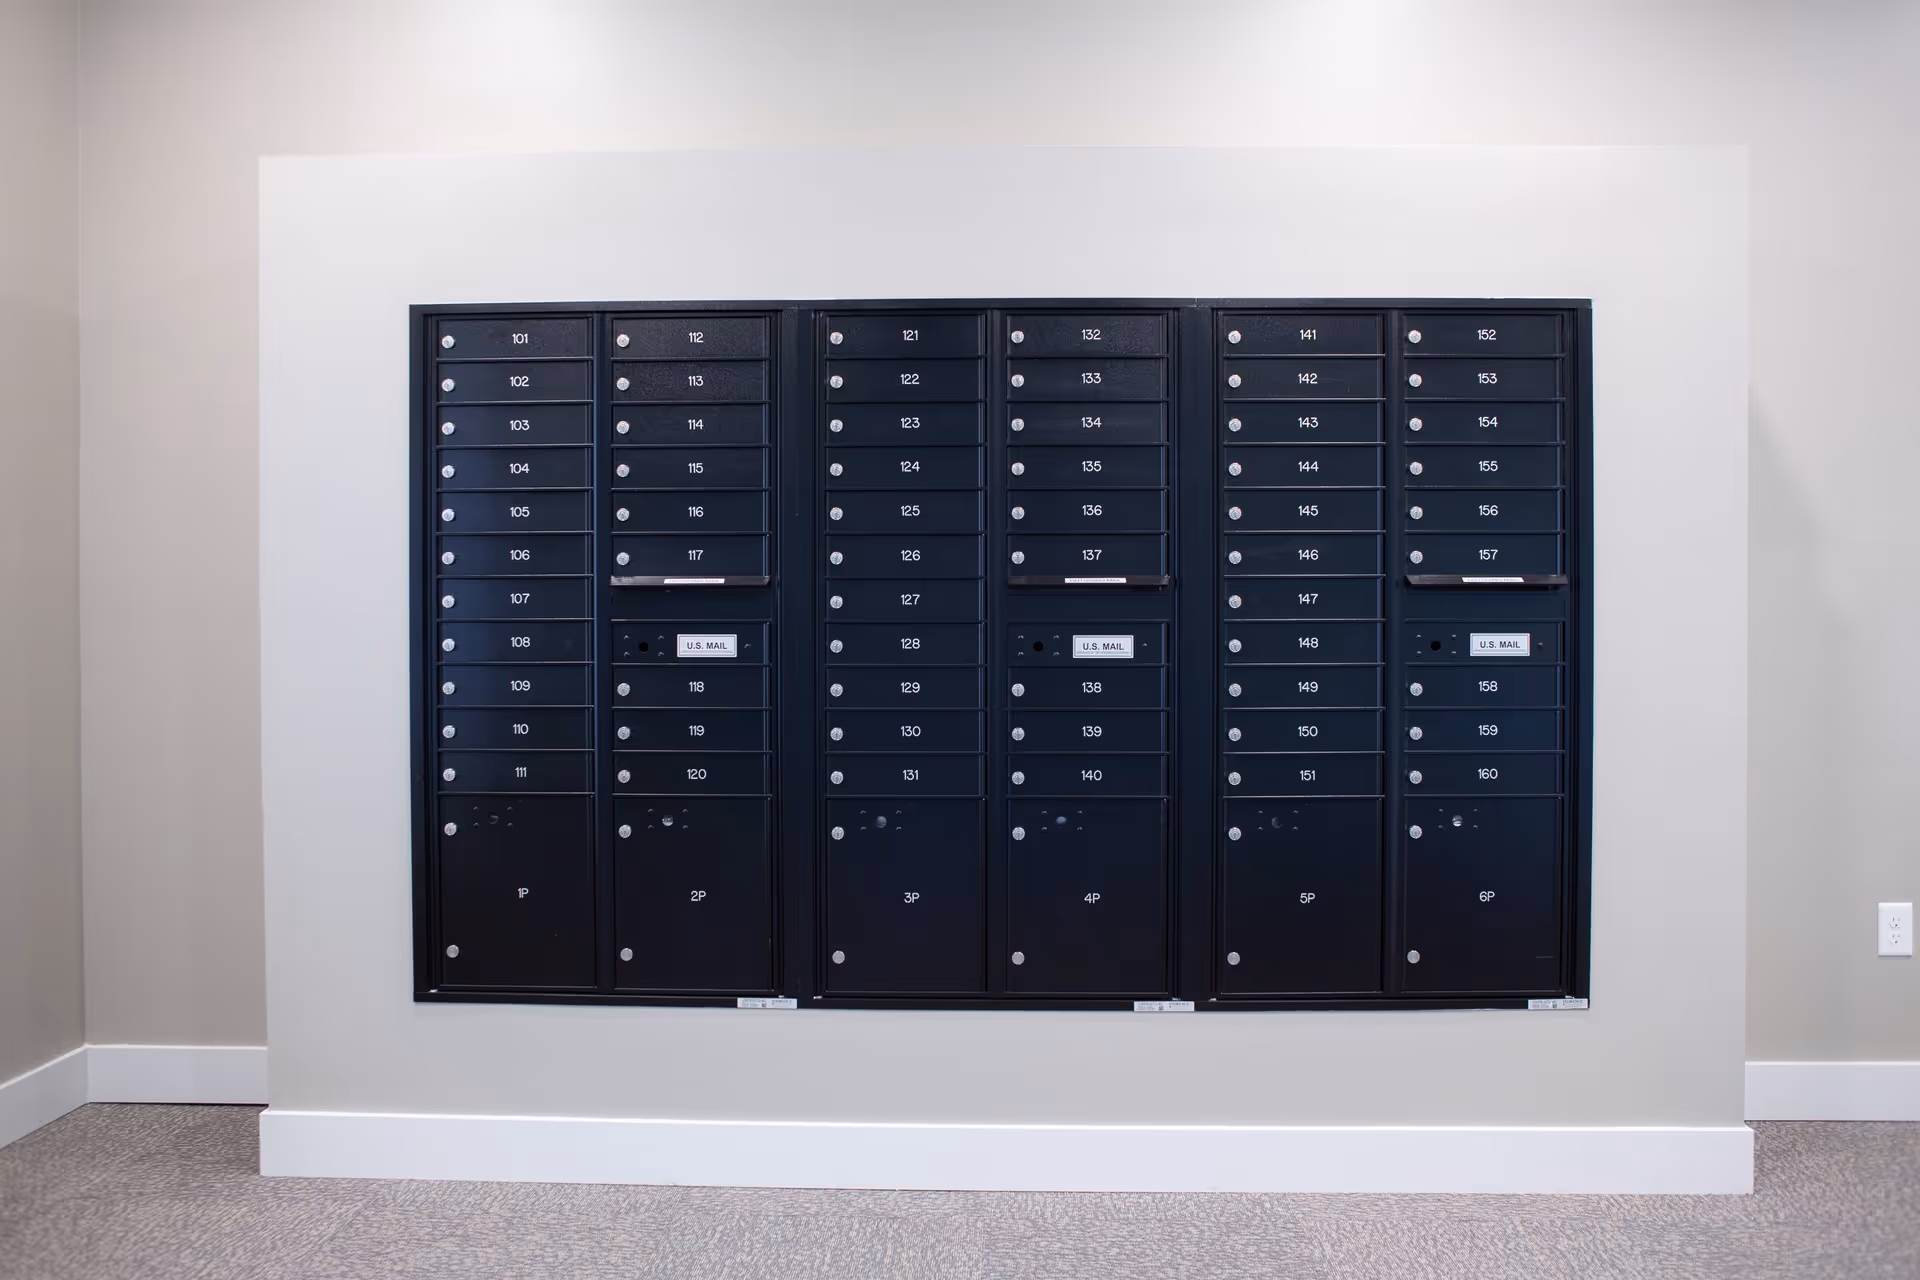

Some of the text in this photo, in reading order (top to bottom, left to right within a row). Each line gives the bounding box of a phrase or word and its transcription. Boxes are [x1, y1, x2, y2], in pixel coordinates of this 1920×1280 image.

[511, 332, 529, 345] 101
[687, 331, 705, 344] 112
[902, 329, 919, 341] 121
[1081, 328, 1102, 341] 132
[1299, 327, 1317, 341] 141
[1476, 328, 1497, 341] 152
[509, 375, 530, 388] 102
[687, 375, 704, 387] 113
[899, 373, 920, 385] 122
[1081, 372, 1102, 385] 133
[1297, 372, 1319, 385] 142
[1477, 372, 1498, 385] 153
[509, 419, 531, 431] 103
[687, 418, 705, 431] 114
[900, 416, 921, 429] 123
[1080, 416, 1103, 429] 134
[1297, 416, 1319, 429] 143
[1477, 416, 1499, 428] 154
[509, 462, 530, 475] 104
[687, 462, 704, 474] 115
[899, 460, 921, 473] 124
[1081, 460, 1103, 473] 135
[1297, 460, 1320, 473] 144
[1478, 460, 1499, 472] 155
[509, 506, 531, 518] 105
[687, 505, 705, 518] 116
[900, 504, 921, 517] 125
[1081, 504, 1103, 517] 136
[1297, 504, 1319, 517] 145
[1478, 504, 1499, 517] 156
[509, 549, 531, 561] 106
[687, 549, 704, 561] 117
[900, 549, 921, 562] 126
[1082, 549, 1103, 561] 137
[1297, 548, 1319, 561] 146
[1478, 548, 1499, 561] 157
[509, 592, 531, 605] 107
[900, 593, 921, 606] 127
[1297, 593, 1319, 605] 147
[510, 636, 531, 648] 108
[686, 641, 728, 650] U.S. MAIL
[900, 637, 921, 650] 128
[1082, 642, 1125, 651] U.S. MAIL
[1298, 636, 1319, 649] 148
[1479, 640, 1521, 649] U.S. MAIL
[510, 679, 531, 692] 109
[688, 680, 705, 693] 118
[900, 681, 921, 694] 129
[1081, 681, 1102, 694] 138
[1297, 681, 1319, 693] 149
[1478, 680, 1499, 692] 158
[512, 723, 530, 735] 110
[688, 724, 705, 737] 119
[900, 725, 922, 737] 130
[1081, 725, 1103, 738] 139
[1297, 725, 1319, 738] 150
[1477, 724, 1499, 736] 159
[514, 766, 527, 778] 111
[686, 768, 707, 780] 120
[902, 769, 919, 781] 131
[1080, 769, 1103, 781] 140
[1299, 769, 1316, 782] 151
[1477, 767, 1499, 780] 160
[517, 887, 529, 899] 1P
[690, 890, 707, 902] 2P
[903, 892, 920, 904] 3P
[1083, 892, 1101, 904] 4P
[1299, 892, 1316, 904] 5P
[1479, 890, 1496, 903] 6P
